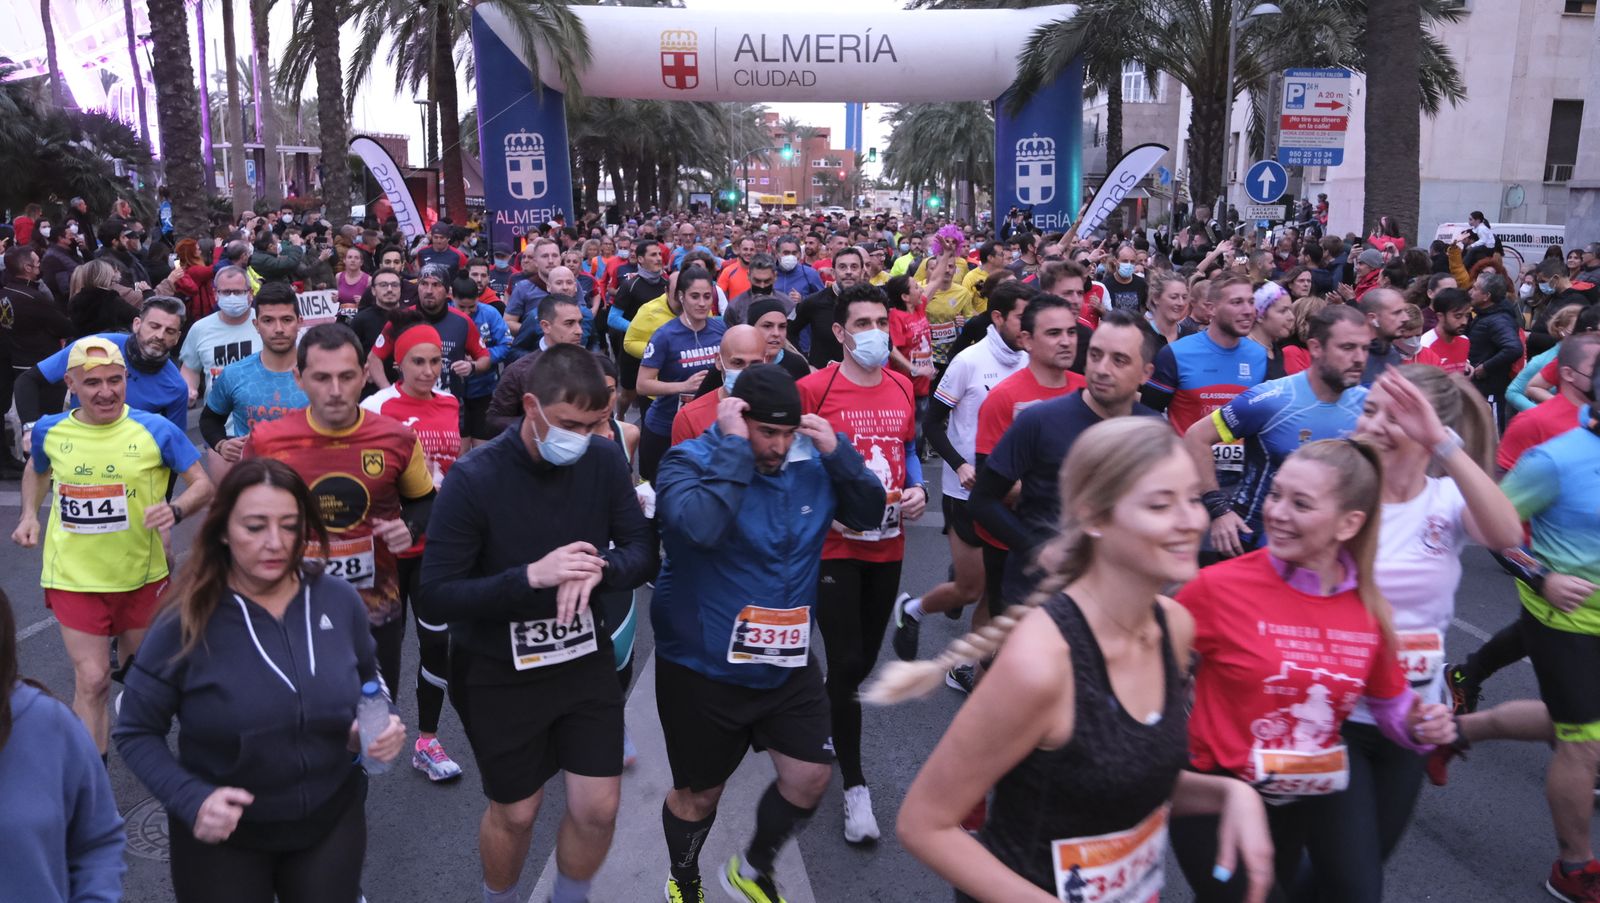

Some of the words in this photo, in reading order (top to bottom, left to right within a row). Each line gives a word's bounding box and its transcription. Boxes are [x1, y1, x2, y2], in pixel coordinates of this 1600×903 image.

[733, 27, 898, 64] ALMERÍA
[733, 69, 817, 87] CIUDAD
[1288, 84, 1304, 102] P
[299, 295, 333, 316] MSA
[69, 499, 114, 517] 614
[531, 612, 583, 643] 364
[748, 627, 800, 645] 3319
